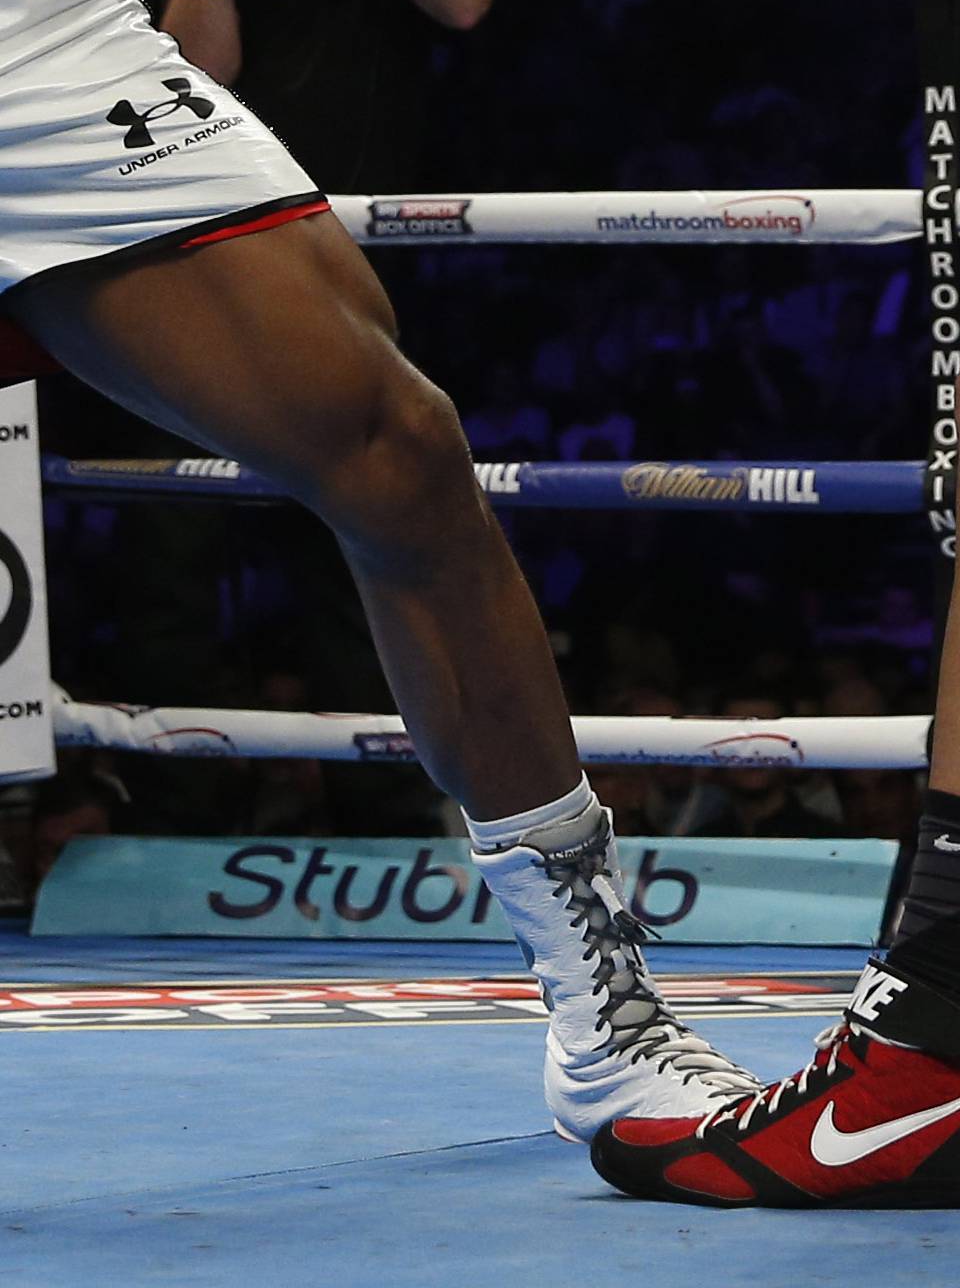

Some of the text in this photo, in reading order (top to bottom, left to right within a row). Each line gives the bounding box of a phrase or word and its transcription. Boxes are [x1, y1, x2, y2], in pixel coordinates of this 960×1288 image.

[118, 116, 246, 176] UNDER ARMOUR
[596, 211, 804, 236] matchroomboxing
[748, 468, 820, 504] HILL
[207, 844, 698, 927] Stubb
[847, 964, 909, 1022] KE
